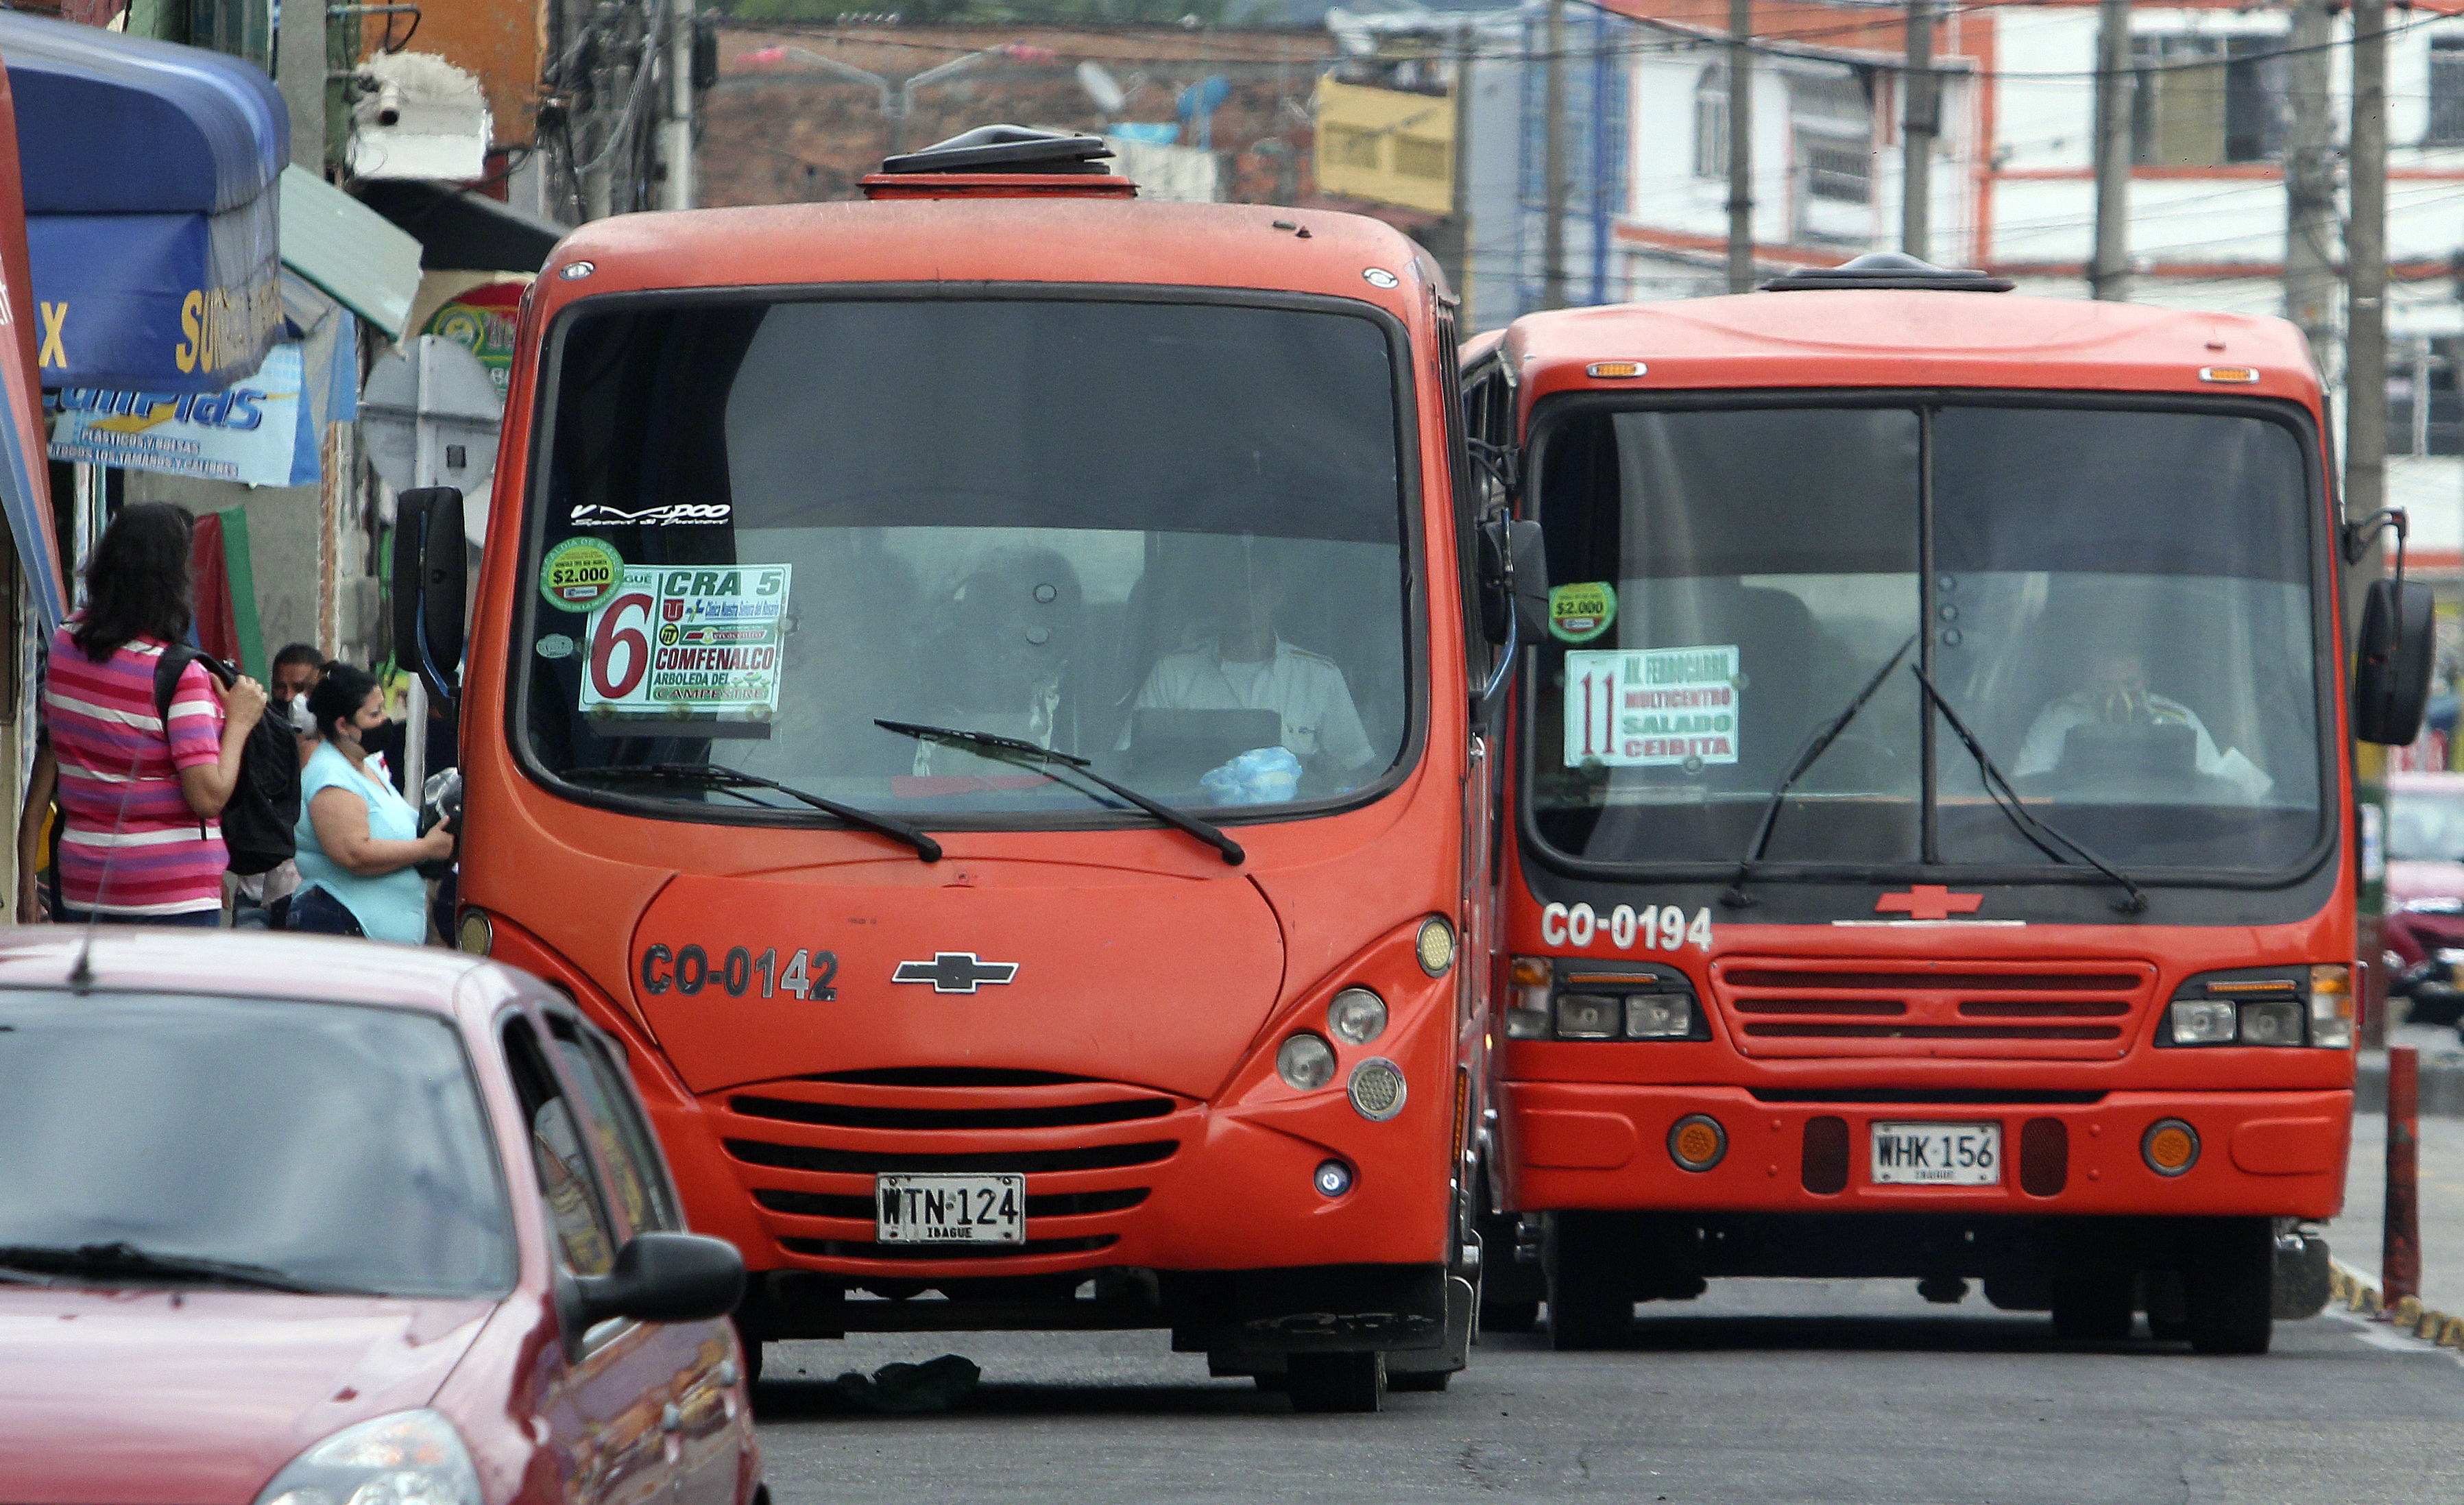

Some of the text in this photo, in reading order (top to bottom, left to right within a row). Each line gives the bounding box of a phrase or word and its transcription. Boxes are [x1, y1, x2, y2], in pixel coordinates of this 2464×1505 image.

[553, 567, 609, 585] $2.000
[664, 571, 782, 596] CRA 5
[1557, 601, 1603, 615] $2.000
[590, 593, 653, 699] 6
[655, 647, 775, 670] COMFENALCO
[653, 672, 729, 685] ARBOLEDA DEL
[656, 688, 765, 699] CAMPESTRE
[1625, 688, 1730, 708] MULTICENTRO
[1580, 671, 1615, 755] 11
[1623, 714, 1731, 735] SALADO
[1625, 738, 1732, 757] CEIBITA
[1543, 902, 1713, 952] CO-0194
[642, 943, 838, 1001] CO-0142
[927, 1227, 973, 1238] IBAGUE
